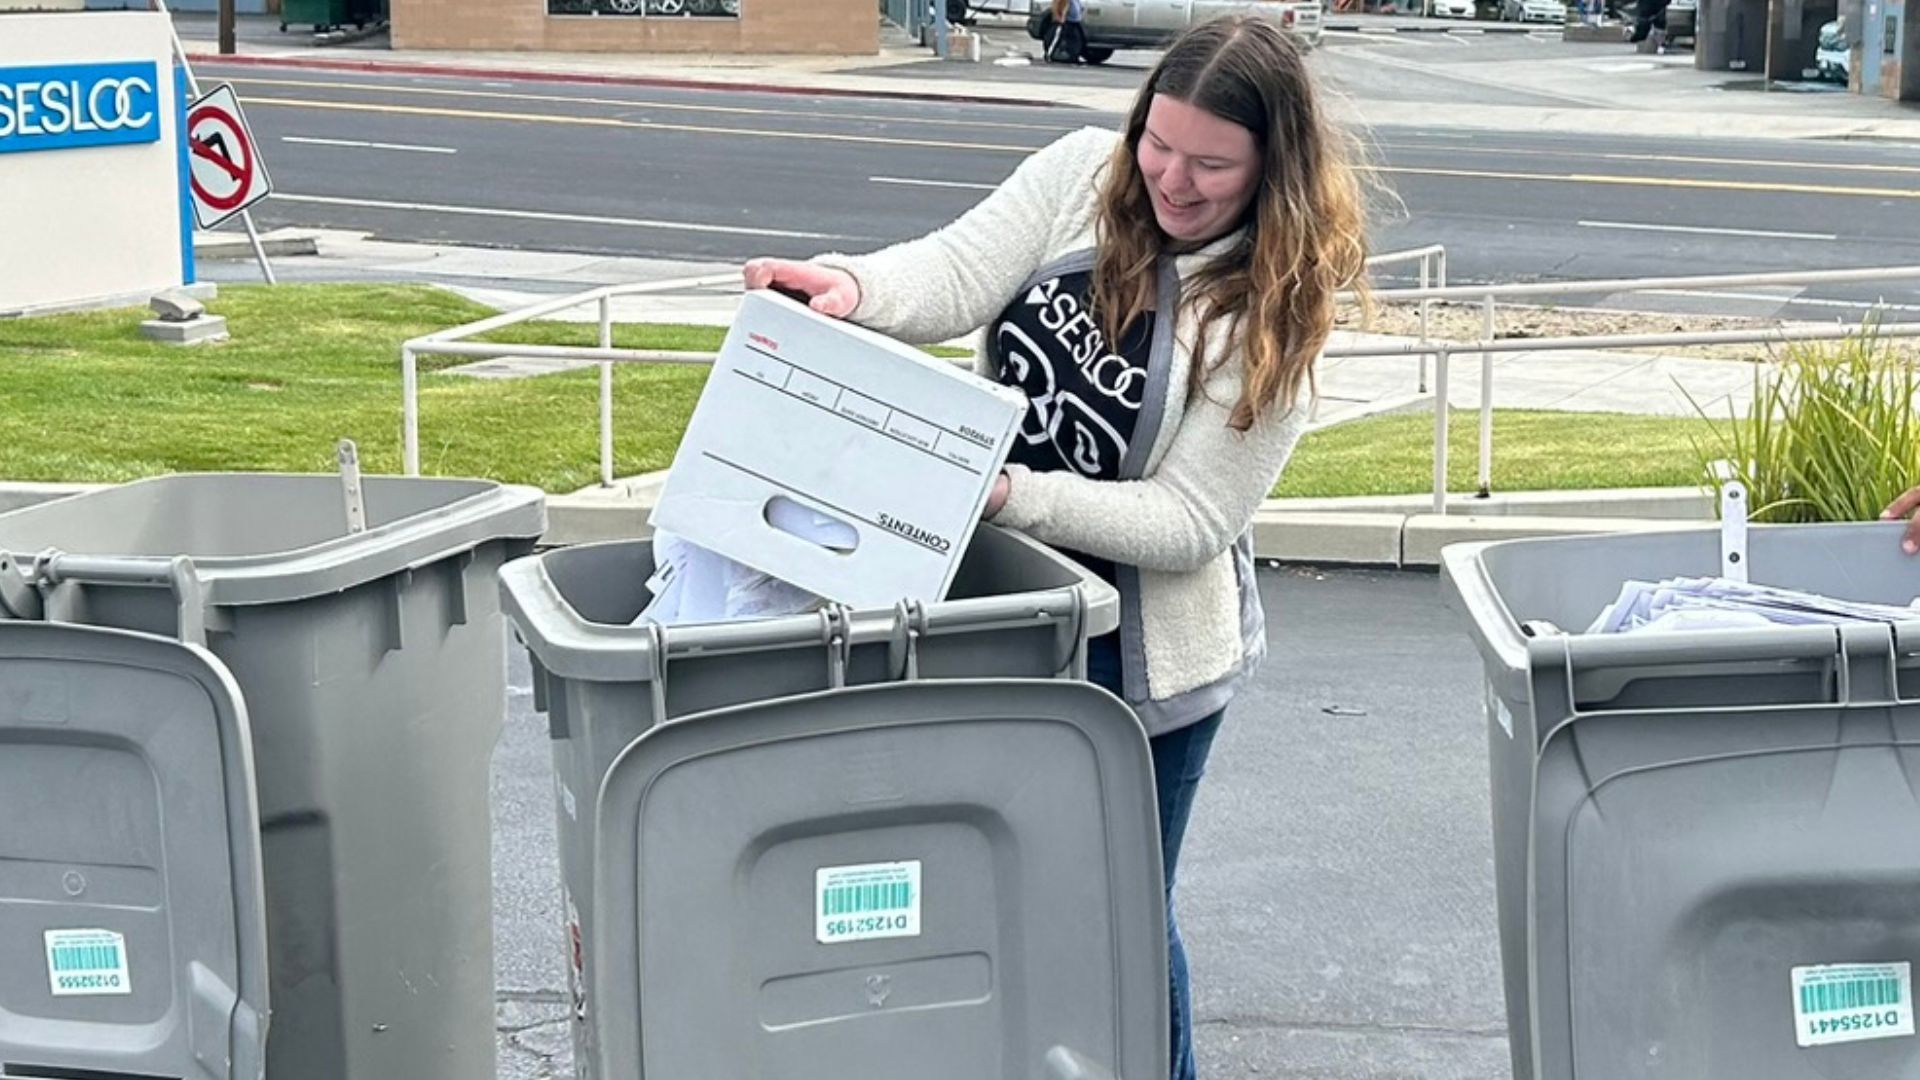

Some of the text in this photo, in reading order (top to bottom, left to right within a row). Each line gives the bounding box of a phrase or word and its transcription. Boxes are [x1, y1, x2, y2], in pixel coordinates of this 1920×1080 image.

[0, 77, 152, 137] SESLOC
[1038, 293, 1147, 409] SESLOC
[826, 915, 907, 936] D1252195
[58, 974, 121, 988] D1252555
[1810, 1011, 1898, 1034] D1255441
